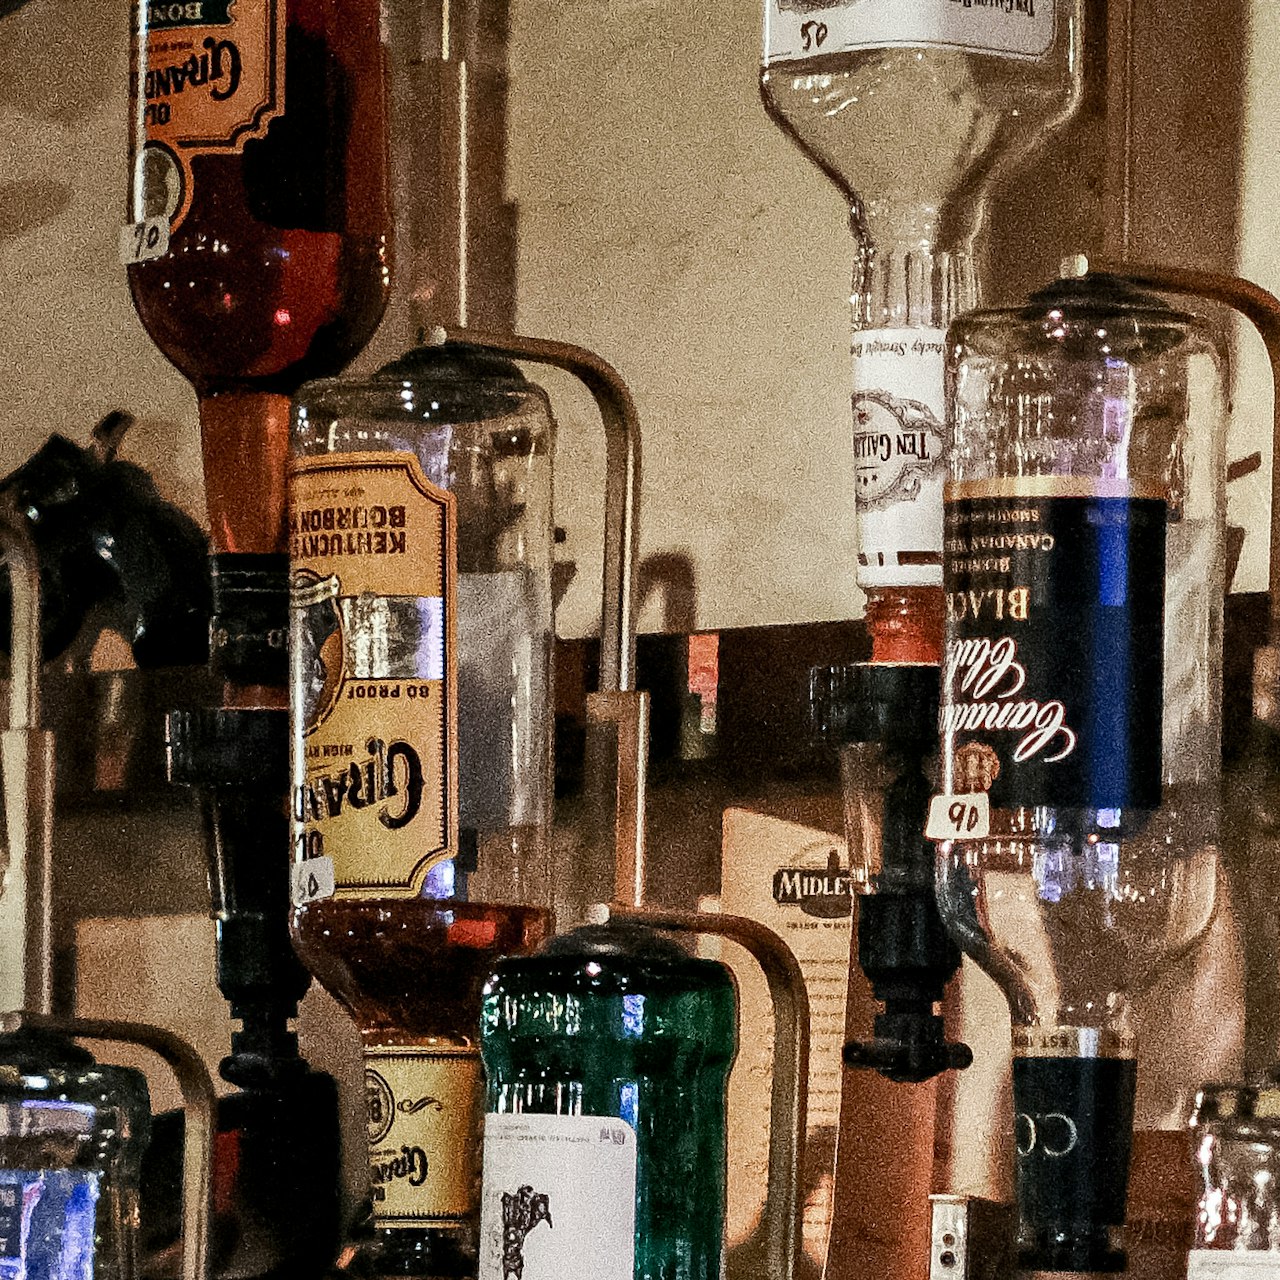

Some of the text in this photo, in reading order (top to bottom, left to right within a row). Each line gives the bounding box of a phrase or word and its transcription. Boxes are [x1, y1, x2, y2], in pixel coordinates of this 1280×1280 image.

[896, 433, 930, 462] TEN
[301, 505, 406, 532] BOURBON
[301, 532, 406, 559] KENTUCKY
[969, 534, 1055, 551] CANADIAN
[347, 685, 430, 699] 80 PROOF
[948, 802, 980, 832] 90
[778, 871, 850, 900] MIDLE
